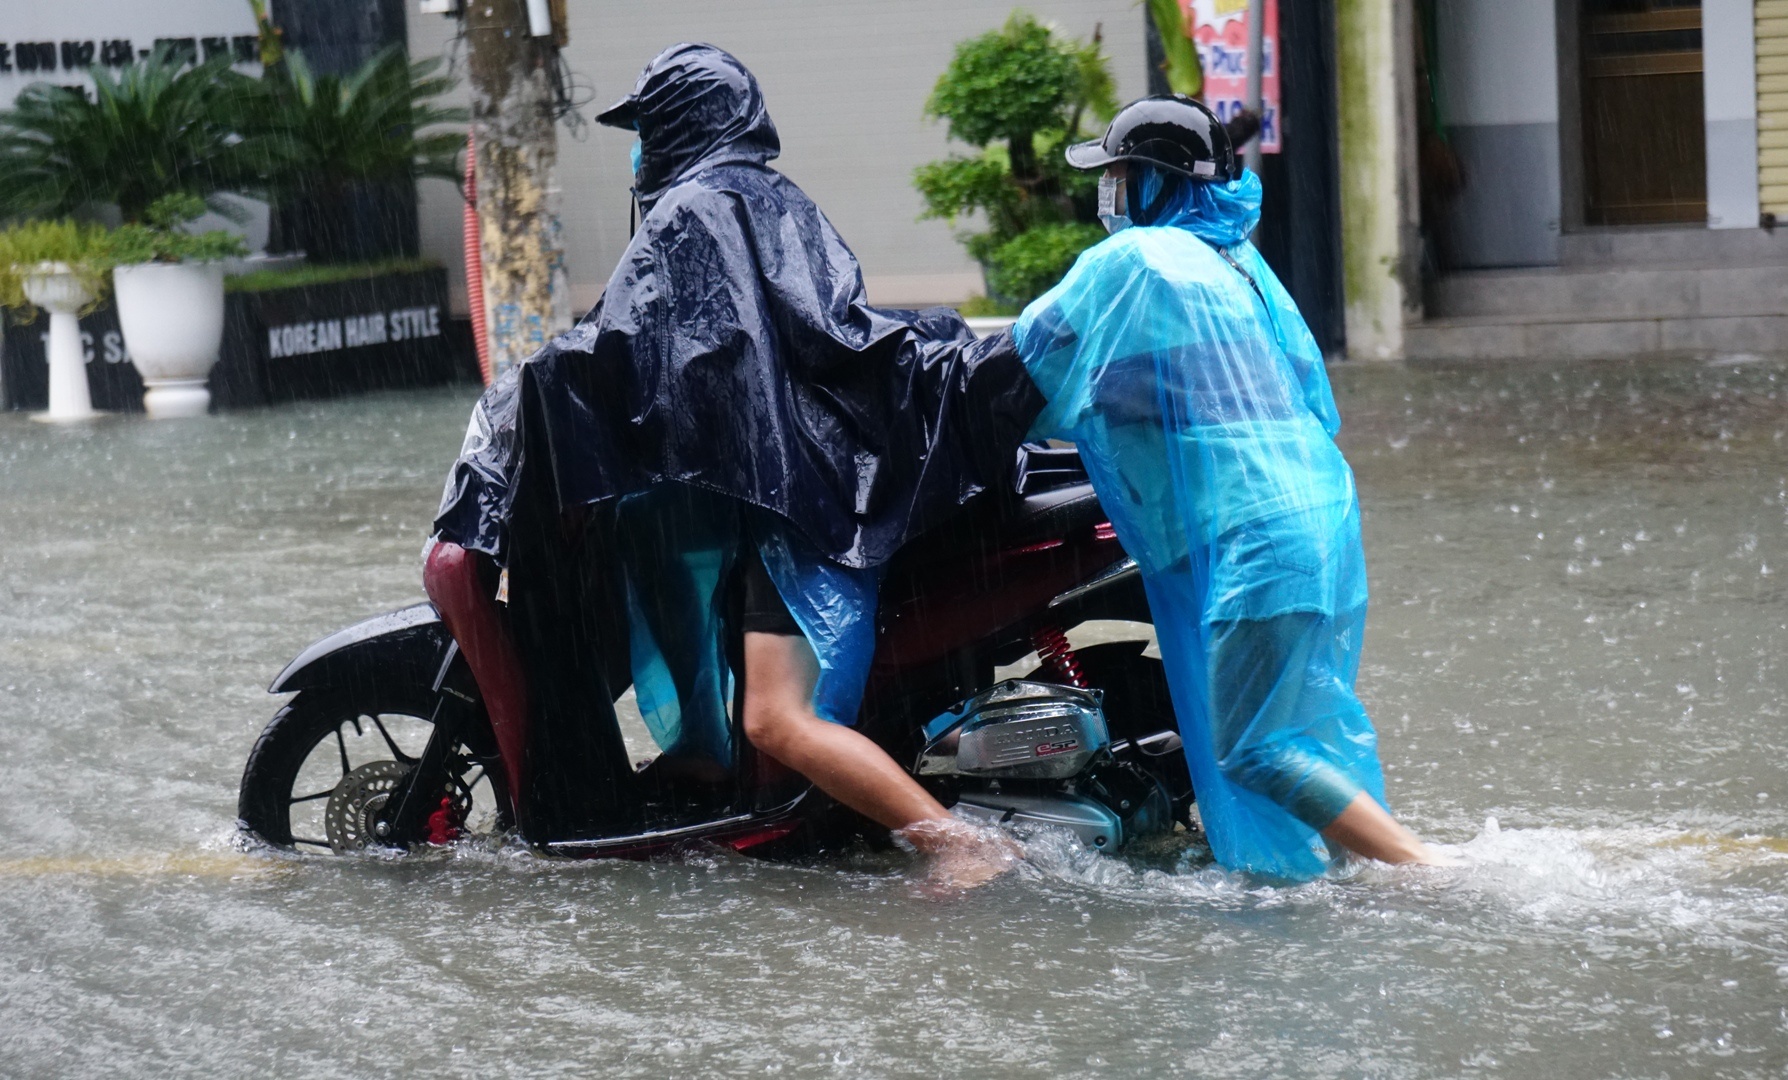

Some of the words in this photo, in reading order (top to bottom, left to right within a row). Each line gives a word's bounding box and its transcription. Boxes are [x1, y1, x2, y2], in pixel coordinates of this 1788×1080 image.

[268, 320, 342, 360] KOREAN
[345, 310, 388, 348] HAIR
[389, 304, 441, 342] STYLE
